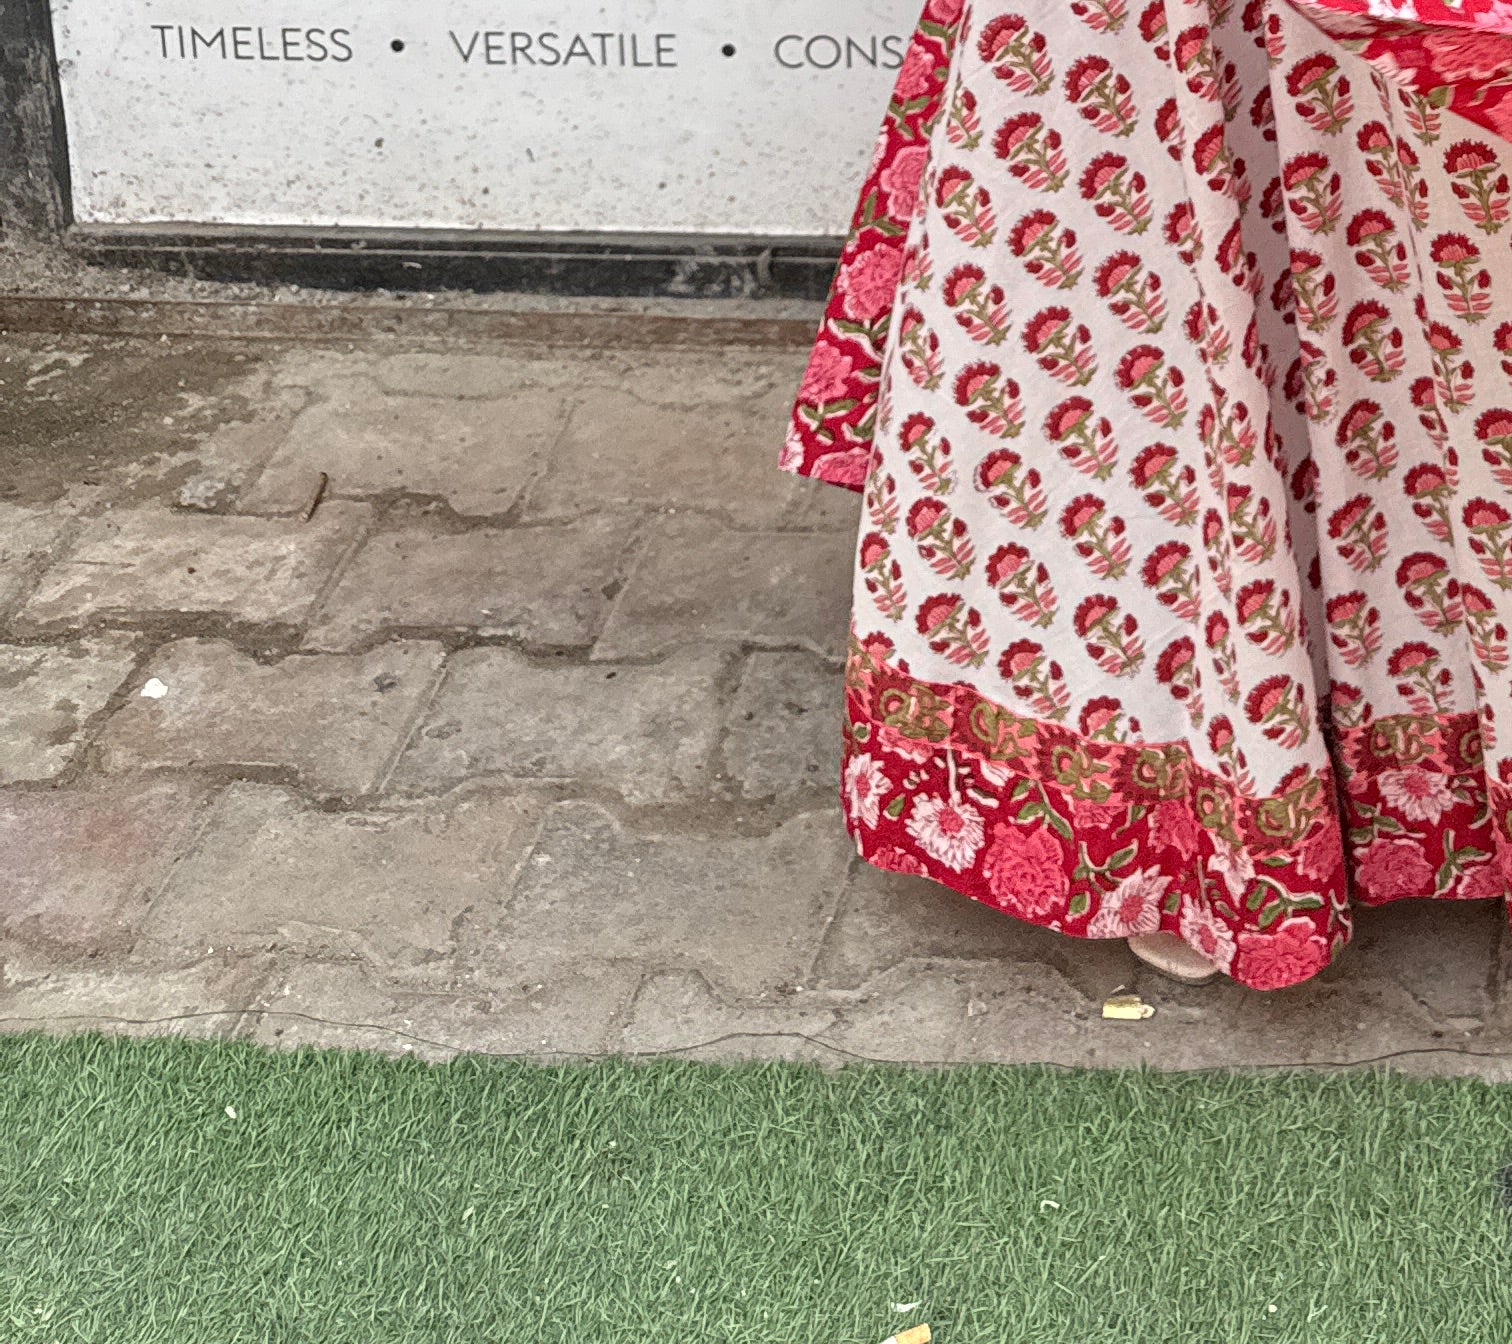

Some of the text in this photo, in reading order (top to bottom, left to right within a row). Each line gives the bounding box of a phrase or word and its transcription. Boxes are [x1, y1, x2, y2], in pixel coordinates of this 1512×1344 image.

[150, 24, 906, 70] TIMELESS VERSATILE CONS
